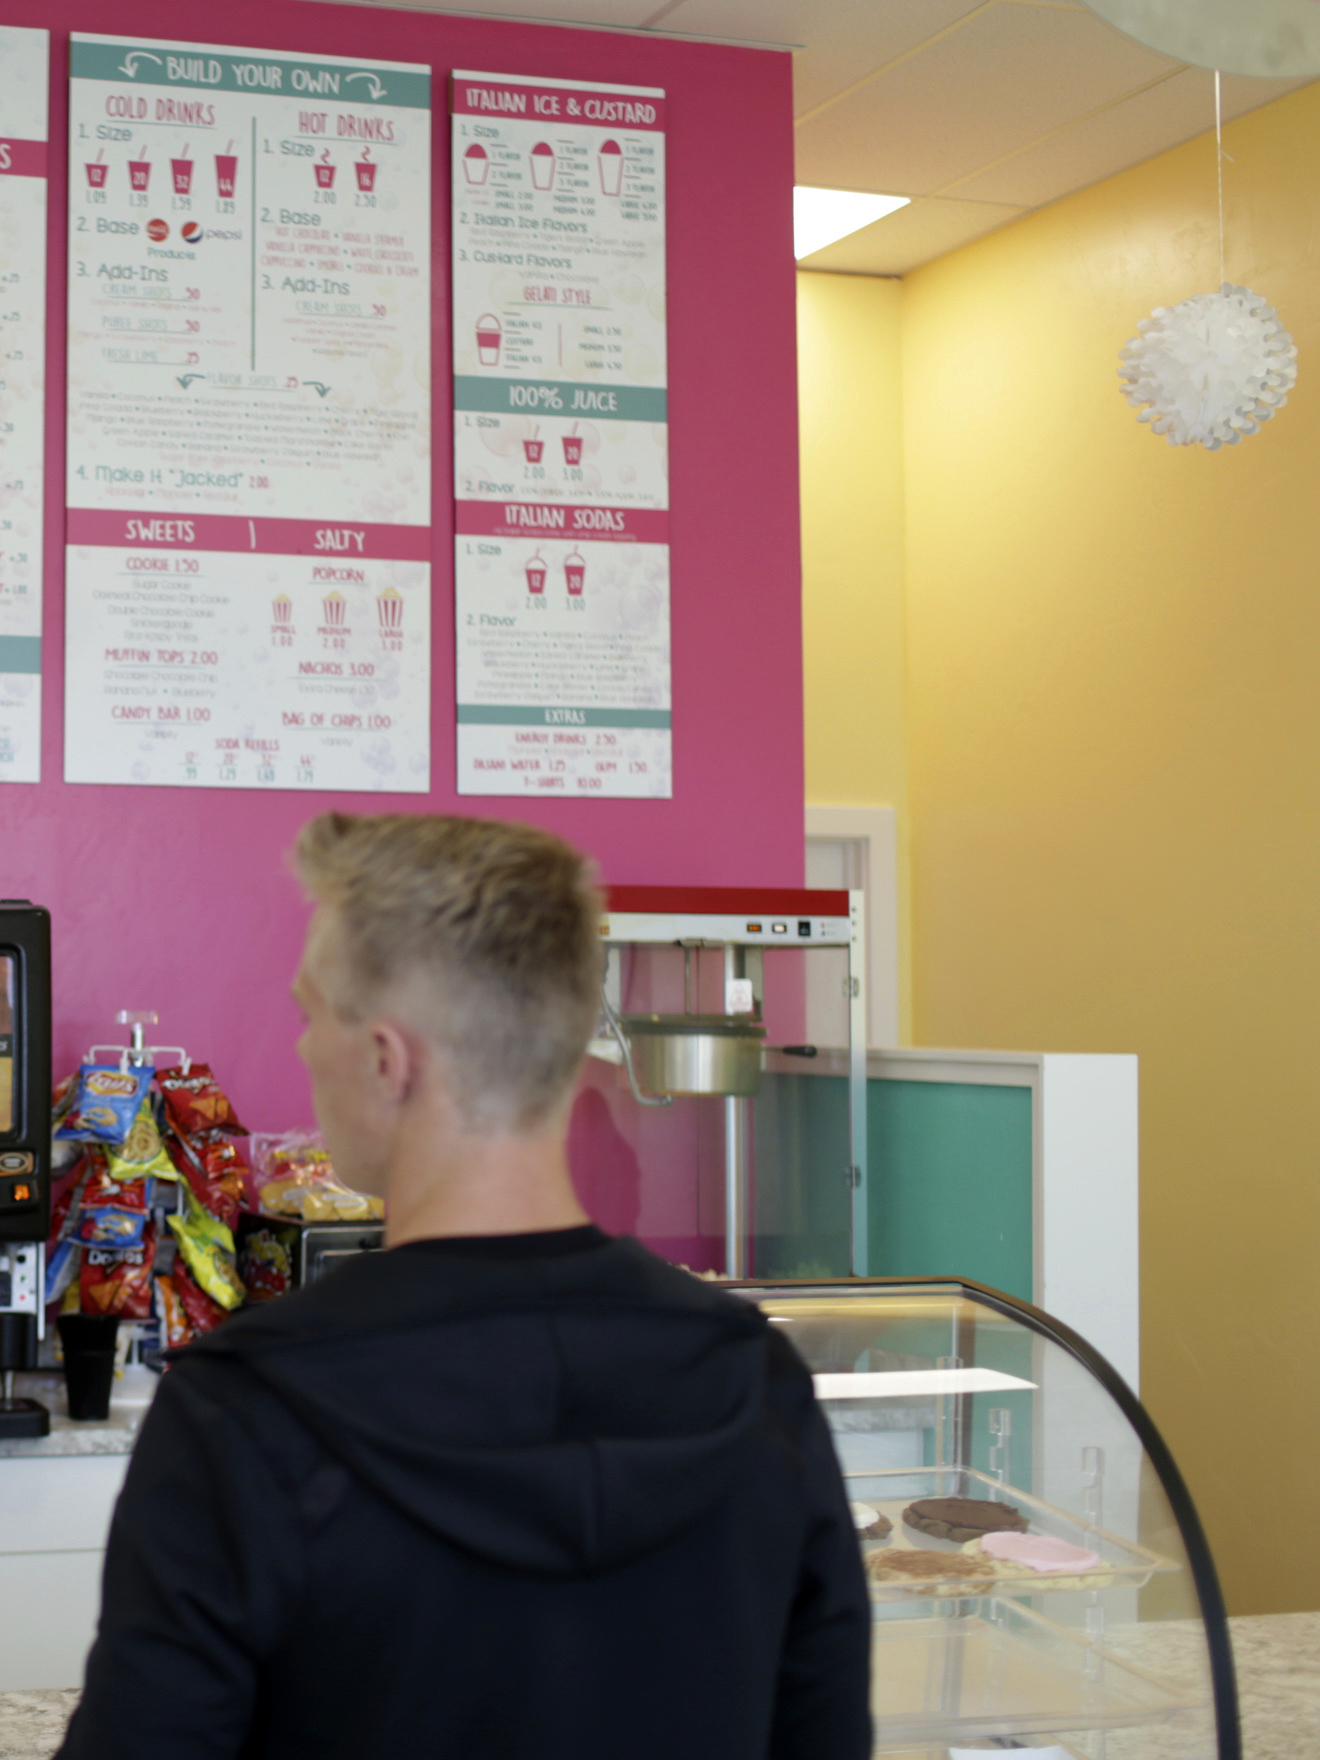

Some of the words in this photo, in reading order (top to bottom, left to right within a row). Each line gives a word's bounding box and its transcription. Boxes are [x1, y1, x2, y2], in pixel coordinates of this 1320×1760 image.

[166, 56, 222, 83] BUILD
[231, 63, 282, 90] YOUR
[291, 69, 341, 95] OWN
[105, 95, 148, 119] COLD
[155, 98, 216, 126] DRINKS
[466, 88, 526, 113] ITALIAN
[533, 94, 561, 115] ICE
[566, 96, 581, 117] &
[584, 99, 657, 125] CUSTARD
[96, 124, 133, 142] Size
[298, 110, 329, 135] HOT
[336, 114, 395, 142] DRINKS
[473, 125, 500, 139] Size
[280, 140, 316, 157] Size
[96, 217, 140, 235] Base
[280, 208, 321, 226] Base
[473, 212, 516, 229] Italian
[517, 214, 540, 230] Ice
[542, 217, 589, 234] Flavors
[206, 227, 242, 240] pepsi
[473, 250, 525, 267] Custard
[527, 253, 573, 269] Flavors
[97, 263, 169, 282] Add-Ins
[281, 276, 351, 295] Add-Ins
[562, 288, 593, 306] STYLE
[509, 385, 564, 410] 100%
[570, 389, 618, 411] JUICE
[95, 465, 144, 484] Make
[478, 481, 516, 495] Flavor
[505, 505, 565, 529] ITALIAN
[572, 508, 626, 532] SODAS
[125, 519, 195, 543] SWEETS
[313, 528, 366, 552] SALTY
[125, 557, 169, 572] COOKIE
[312, 566, 365, 582] POPCORN
[480, 614, 517, 628] Flavor
[105, 648, 151, 662] MUFFIN
[156, 649, 185, 664] TOPS
[190, 651, 218, 666] 2.00
[298, 661, 343, 676] NACHOS
[111, 705, 152, 720] CANDY
[157, 706, 182, 720] BAR
[281, 711, 305, 727] BAG
[310, 712, 325, 727] OF
[331, 713, 363, 729] CHIPS
[545, 708, 586, 725] EXTRAS
